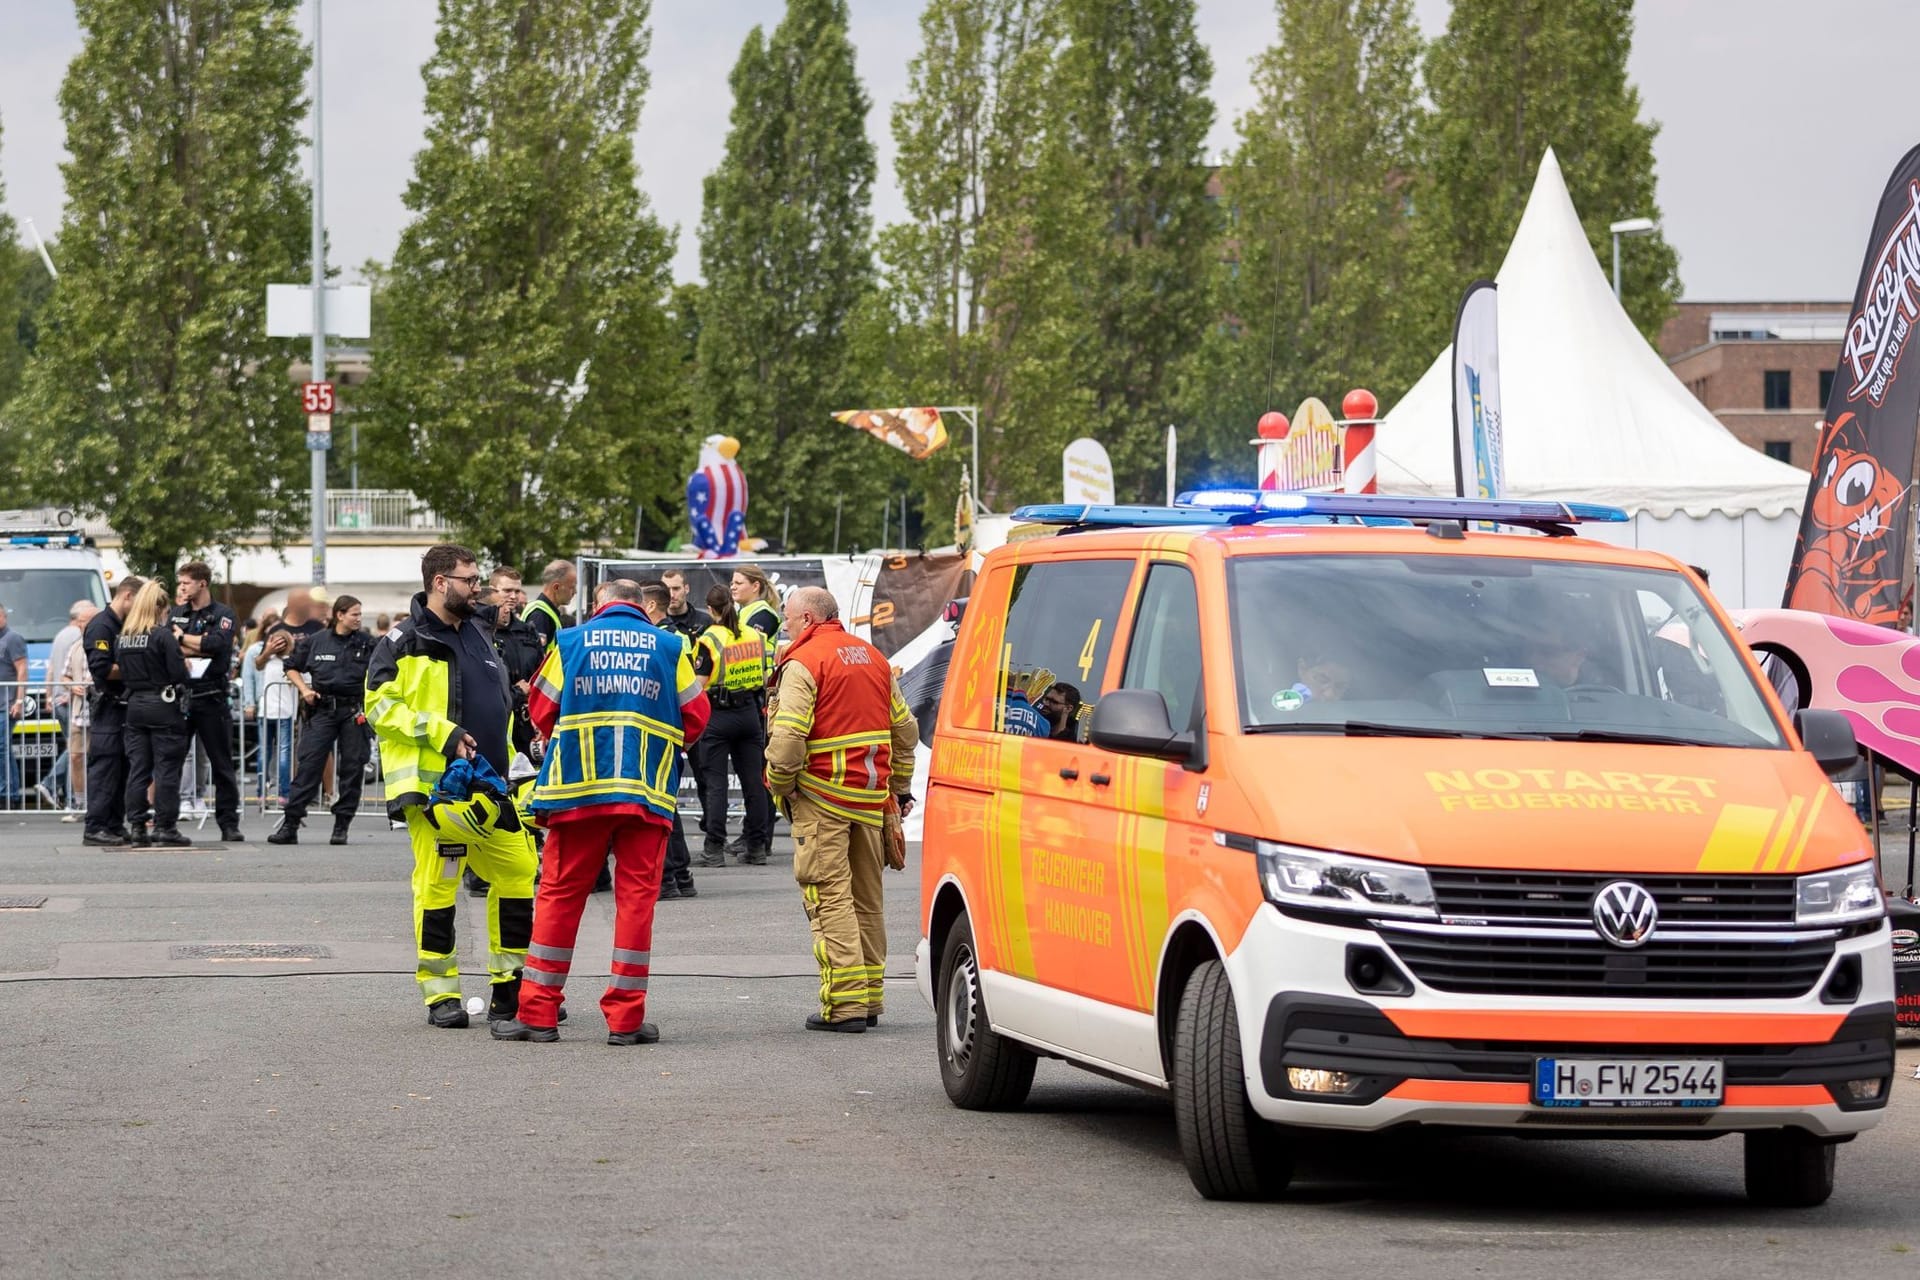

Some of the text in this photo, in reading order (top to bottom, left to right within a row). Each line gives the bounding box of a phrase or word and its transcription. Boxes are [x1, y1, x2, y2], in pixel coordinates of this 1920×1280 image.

[1869, 314, 1909, 401] Rod ya to hell
[305, 384, 332, 411] 55
[872, 601, 895, 627] 2
[119, 634, 149, 648] POLIZEI
[584, 629, 657, 651] LEITENDER
[725, 641, 764, 663] POLIZE
[1078, 618, 1102, 682] 4
[590, 650, 650, 672] NOTARZT
[575, 674, 661, 700] FW HANNOVER
[937, 740, 983, 780] NOTARZT
[1424, 768, 1718, 799] NOTARZT
[1440, 793, 1704, 815] FEUERWEHR
[1032, 848, 1104, 897] FEUERWEHR
[1044, 896, 1113, 949] HANNOVER
[1557, 1065, 1717, 1095] H FW 2544
